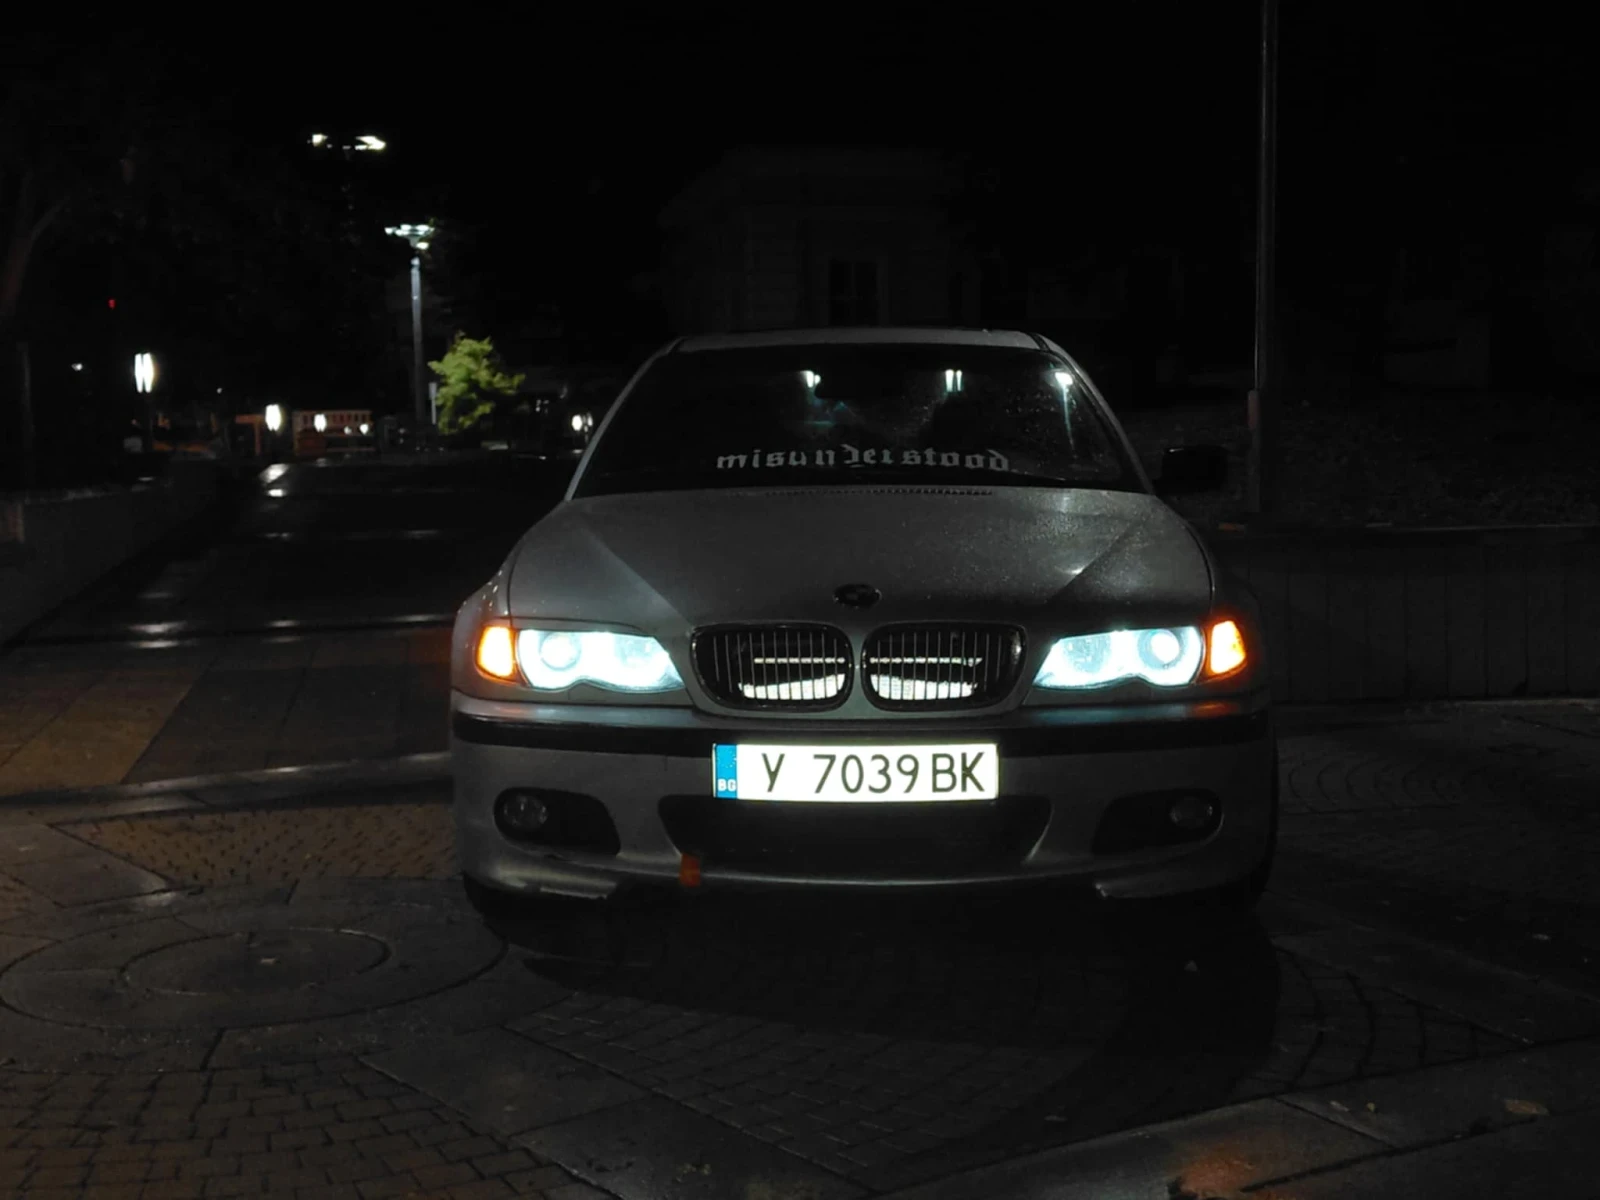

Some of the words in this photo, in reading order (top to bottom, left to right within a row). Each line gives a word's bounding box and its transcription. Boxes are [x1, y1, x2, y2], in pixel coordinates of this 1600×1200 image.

[716, 443, 1010, 472] misunderstood
[718, 778, 737, 791] BG
[813, 754, 920, 794] 7039
[931, 752, 985, 793] BK
